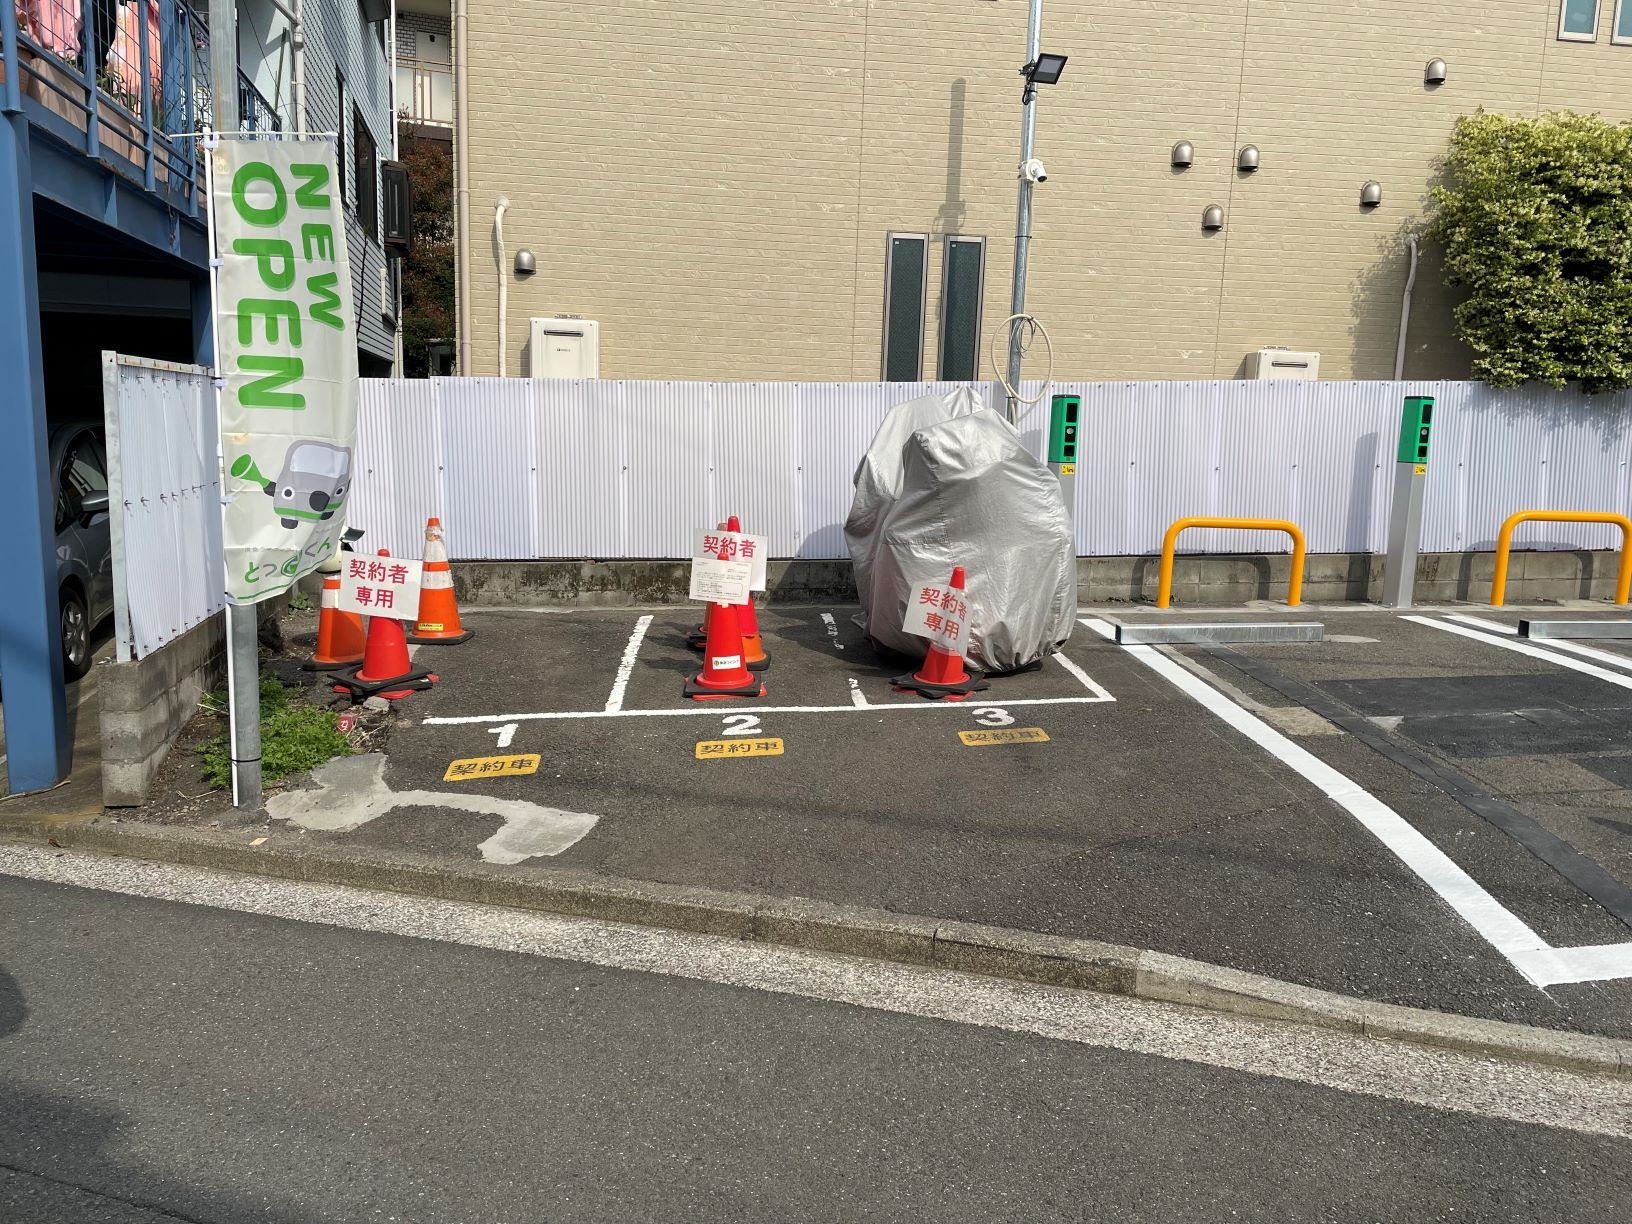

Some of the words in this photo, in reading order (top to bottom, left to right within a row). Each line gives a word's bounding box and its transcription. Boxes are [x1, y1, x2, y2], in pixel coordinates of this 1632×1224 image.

[289, 163, 345, 332] NEW
[231, 161, 306, 410] OPEN
[703, 534, 757, 558] 契約者
[349, 558, 409, 585] 契約者
[355, 585, 394, 609] 専用
[919, 587, 967, 623] 契約者
[923, 612, 960, 641] 専用
[721, 714, 763, 736] 2
[971, 707, 1016, 726] 3
[487, 722, 519, 748] 1
[700, 741, 780, 755] 契約車
[449, 758, 533, 777] 契約車
